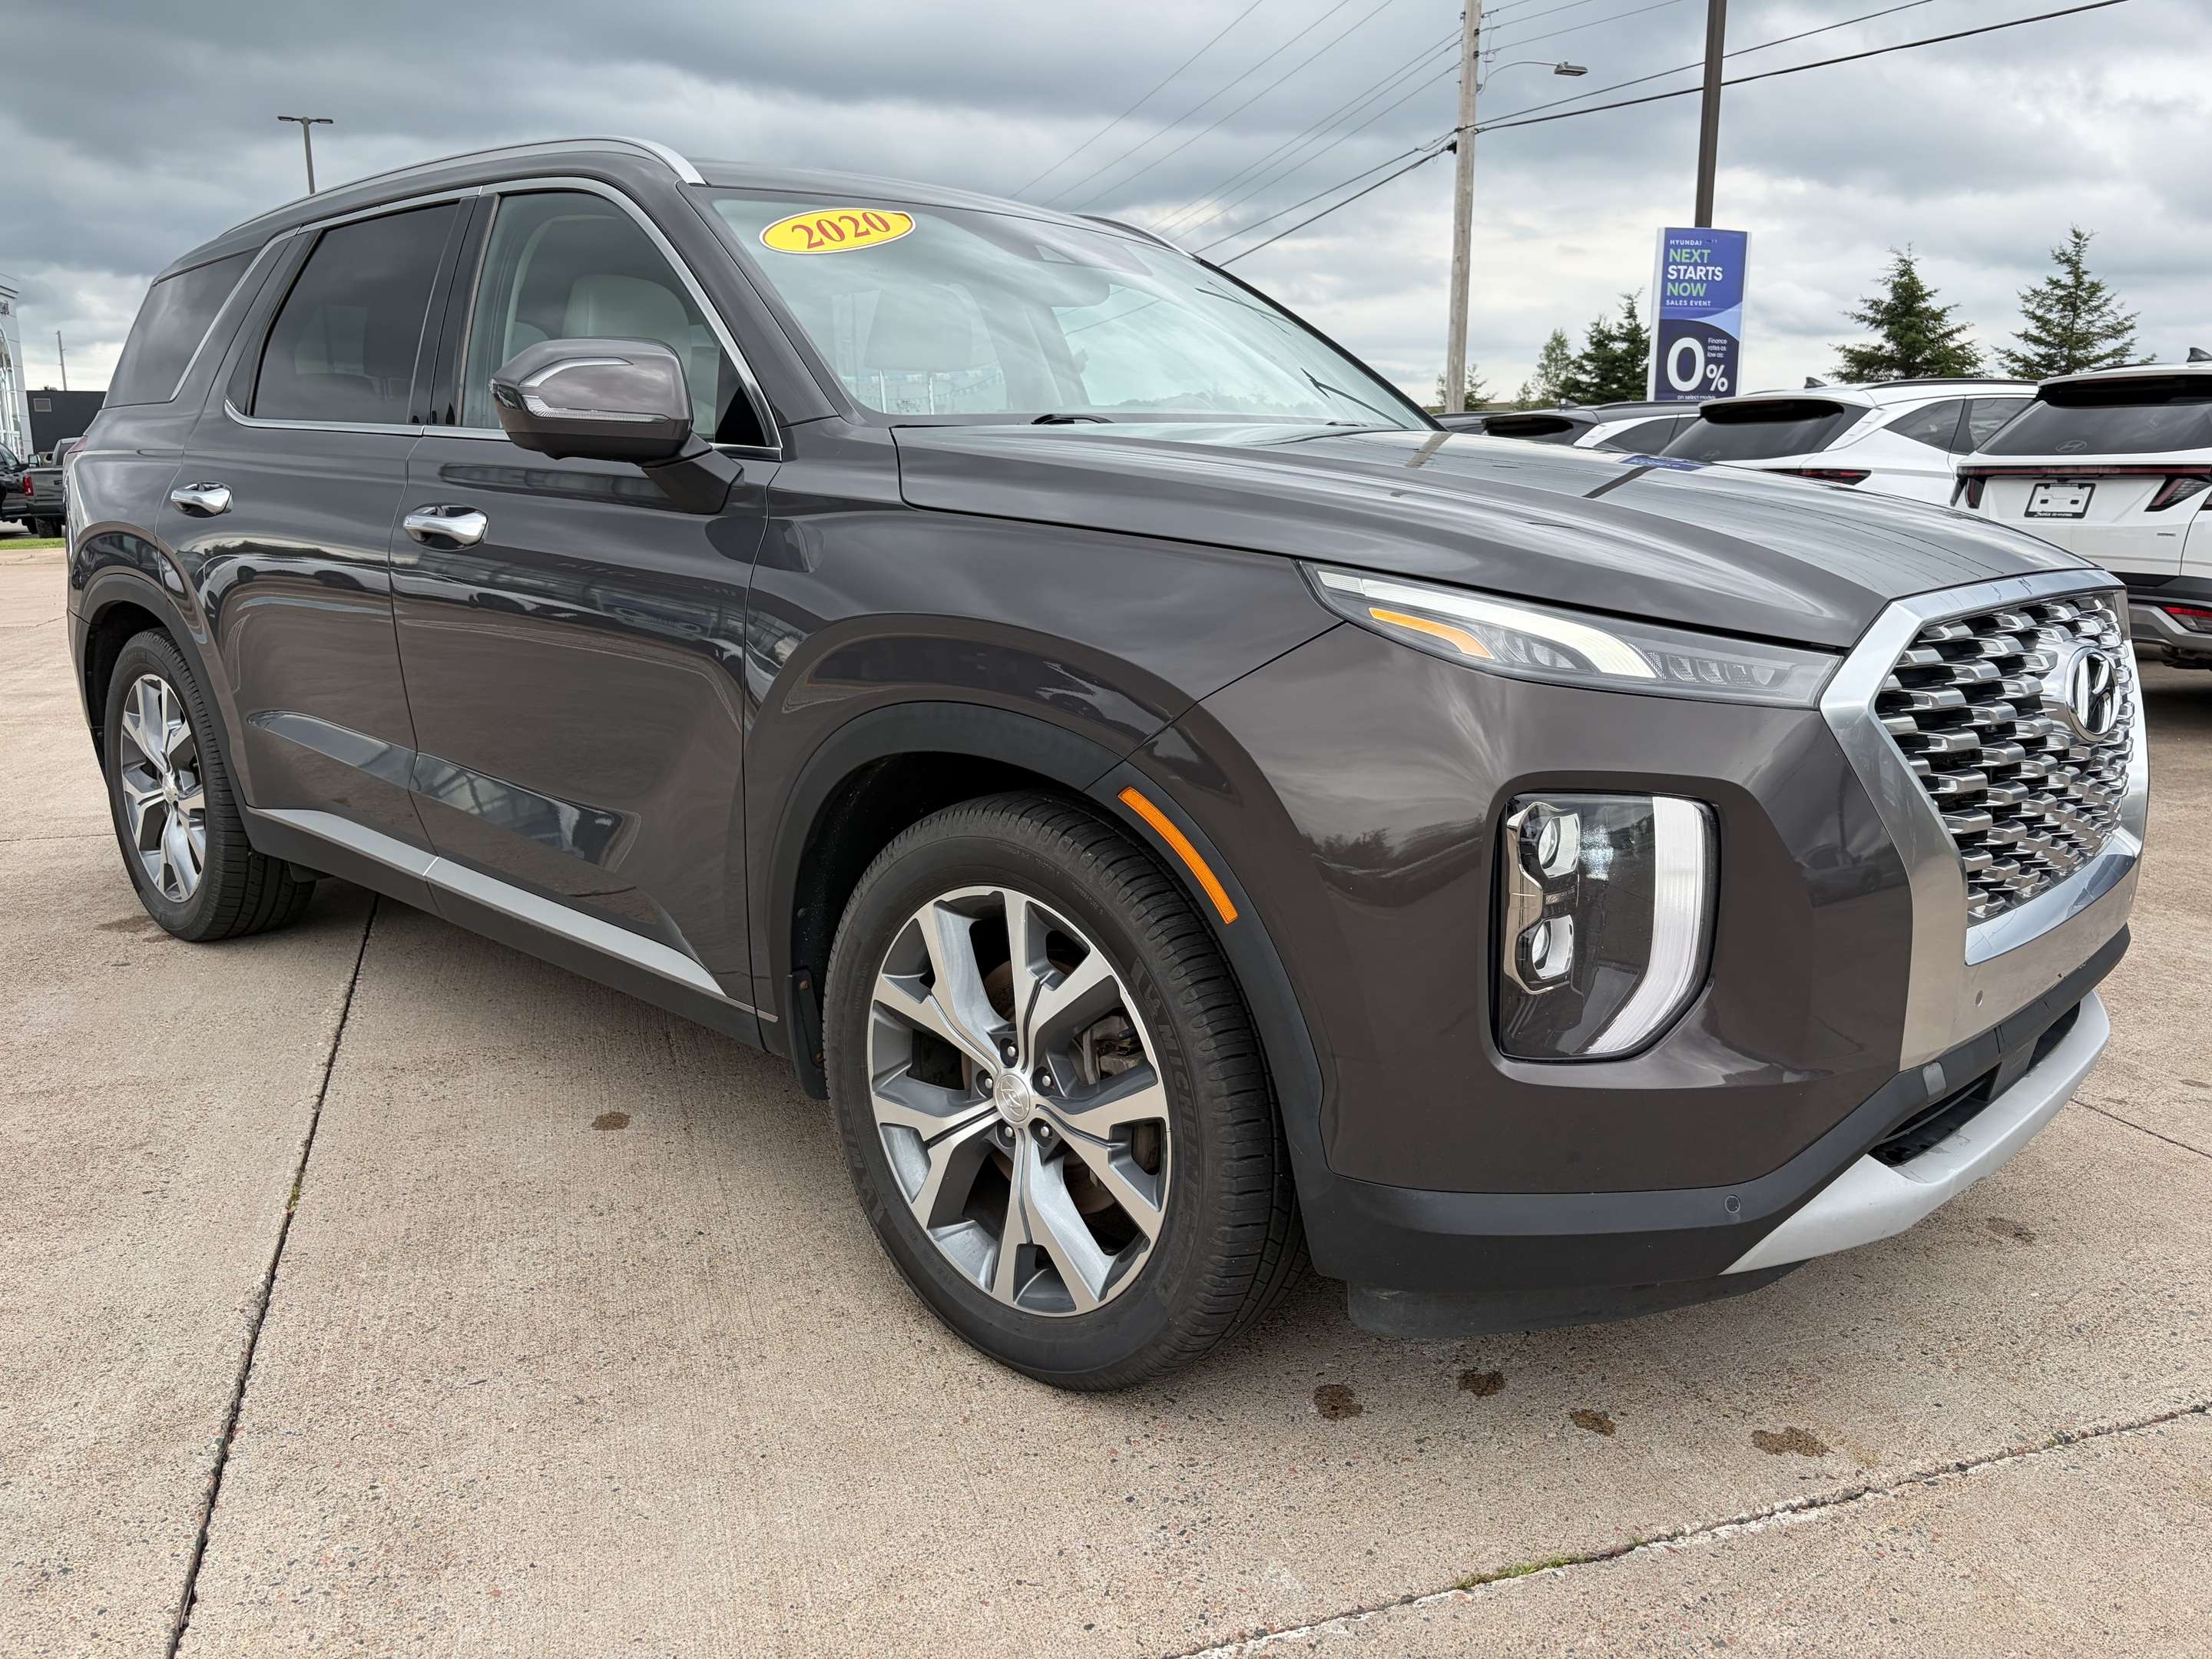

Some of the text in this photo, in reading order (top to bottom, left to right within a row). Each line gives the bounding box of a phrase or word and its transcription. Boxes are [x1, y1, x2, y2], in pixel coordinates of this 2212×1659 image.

[792, 212, 890, 249] 2020
[1669, 248, 1711, 263] NEXT
[1667, 265, 1724, 281] STARTS
[1667, 282, 1707, 296] NOW
[1157, 1024, 1200, 1202] MICHELIN
